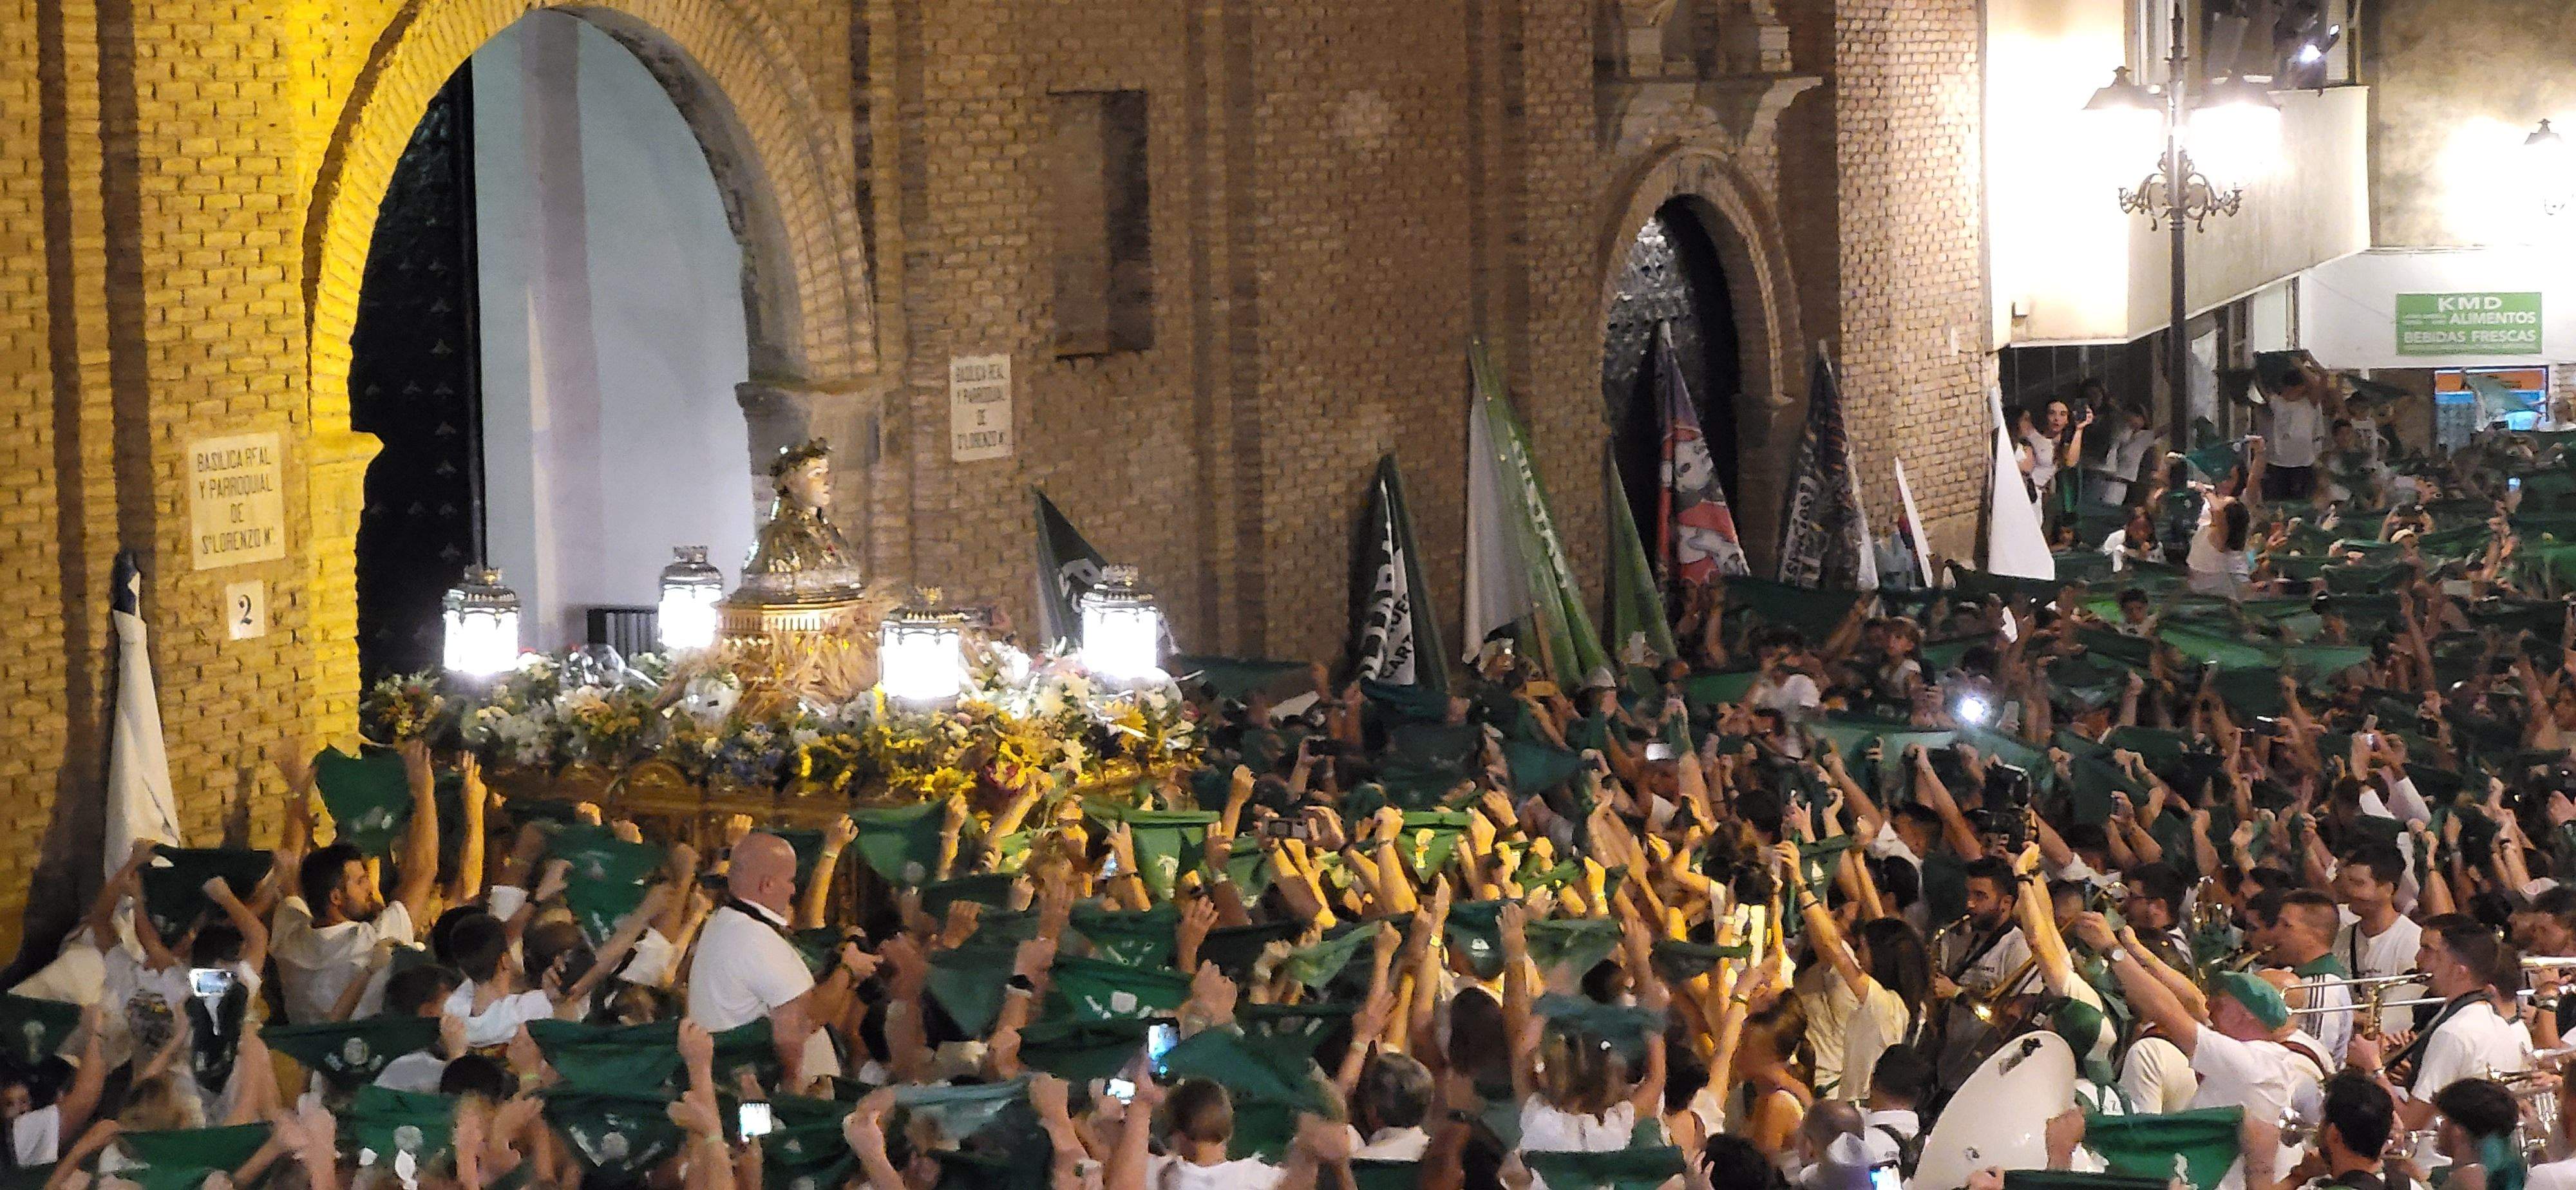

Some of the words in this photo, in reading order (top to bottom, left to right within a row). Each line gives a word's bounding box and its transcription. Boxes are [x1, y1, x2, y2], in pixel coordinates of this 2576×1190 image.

[2438, 297, 2502, 312] KMD
[2448, 312, 2536, 325] ALIMENTOS
[2404, 331, 2466, 343] BEBIDAS
[2471, 330, 2536, 342] FRESCAS
[198, 480, 205, 499] Y
[238, 594, 253, 625] 2
